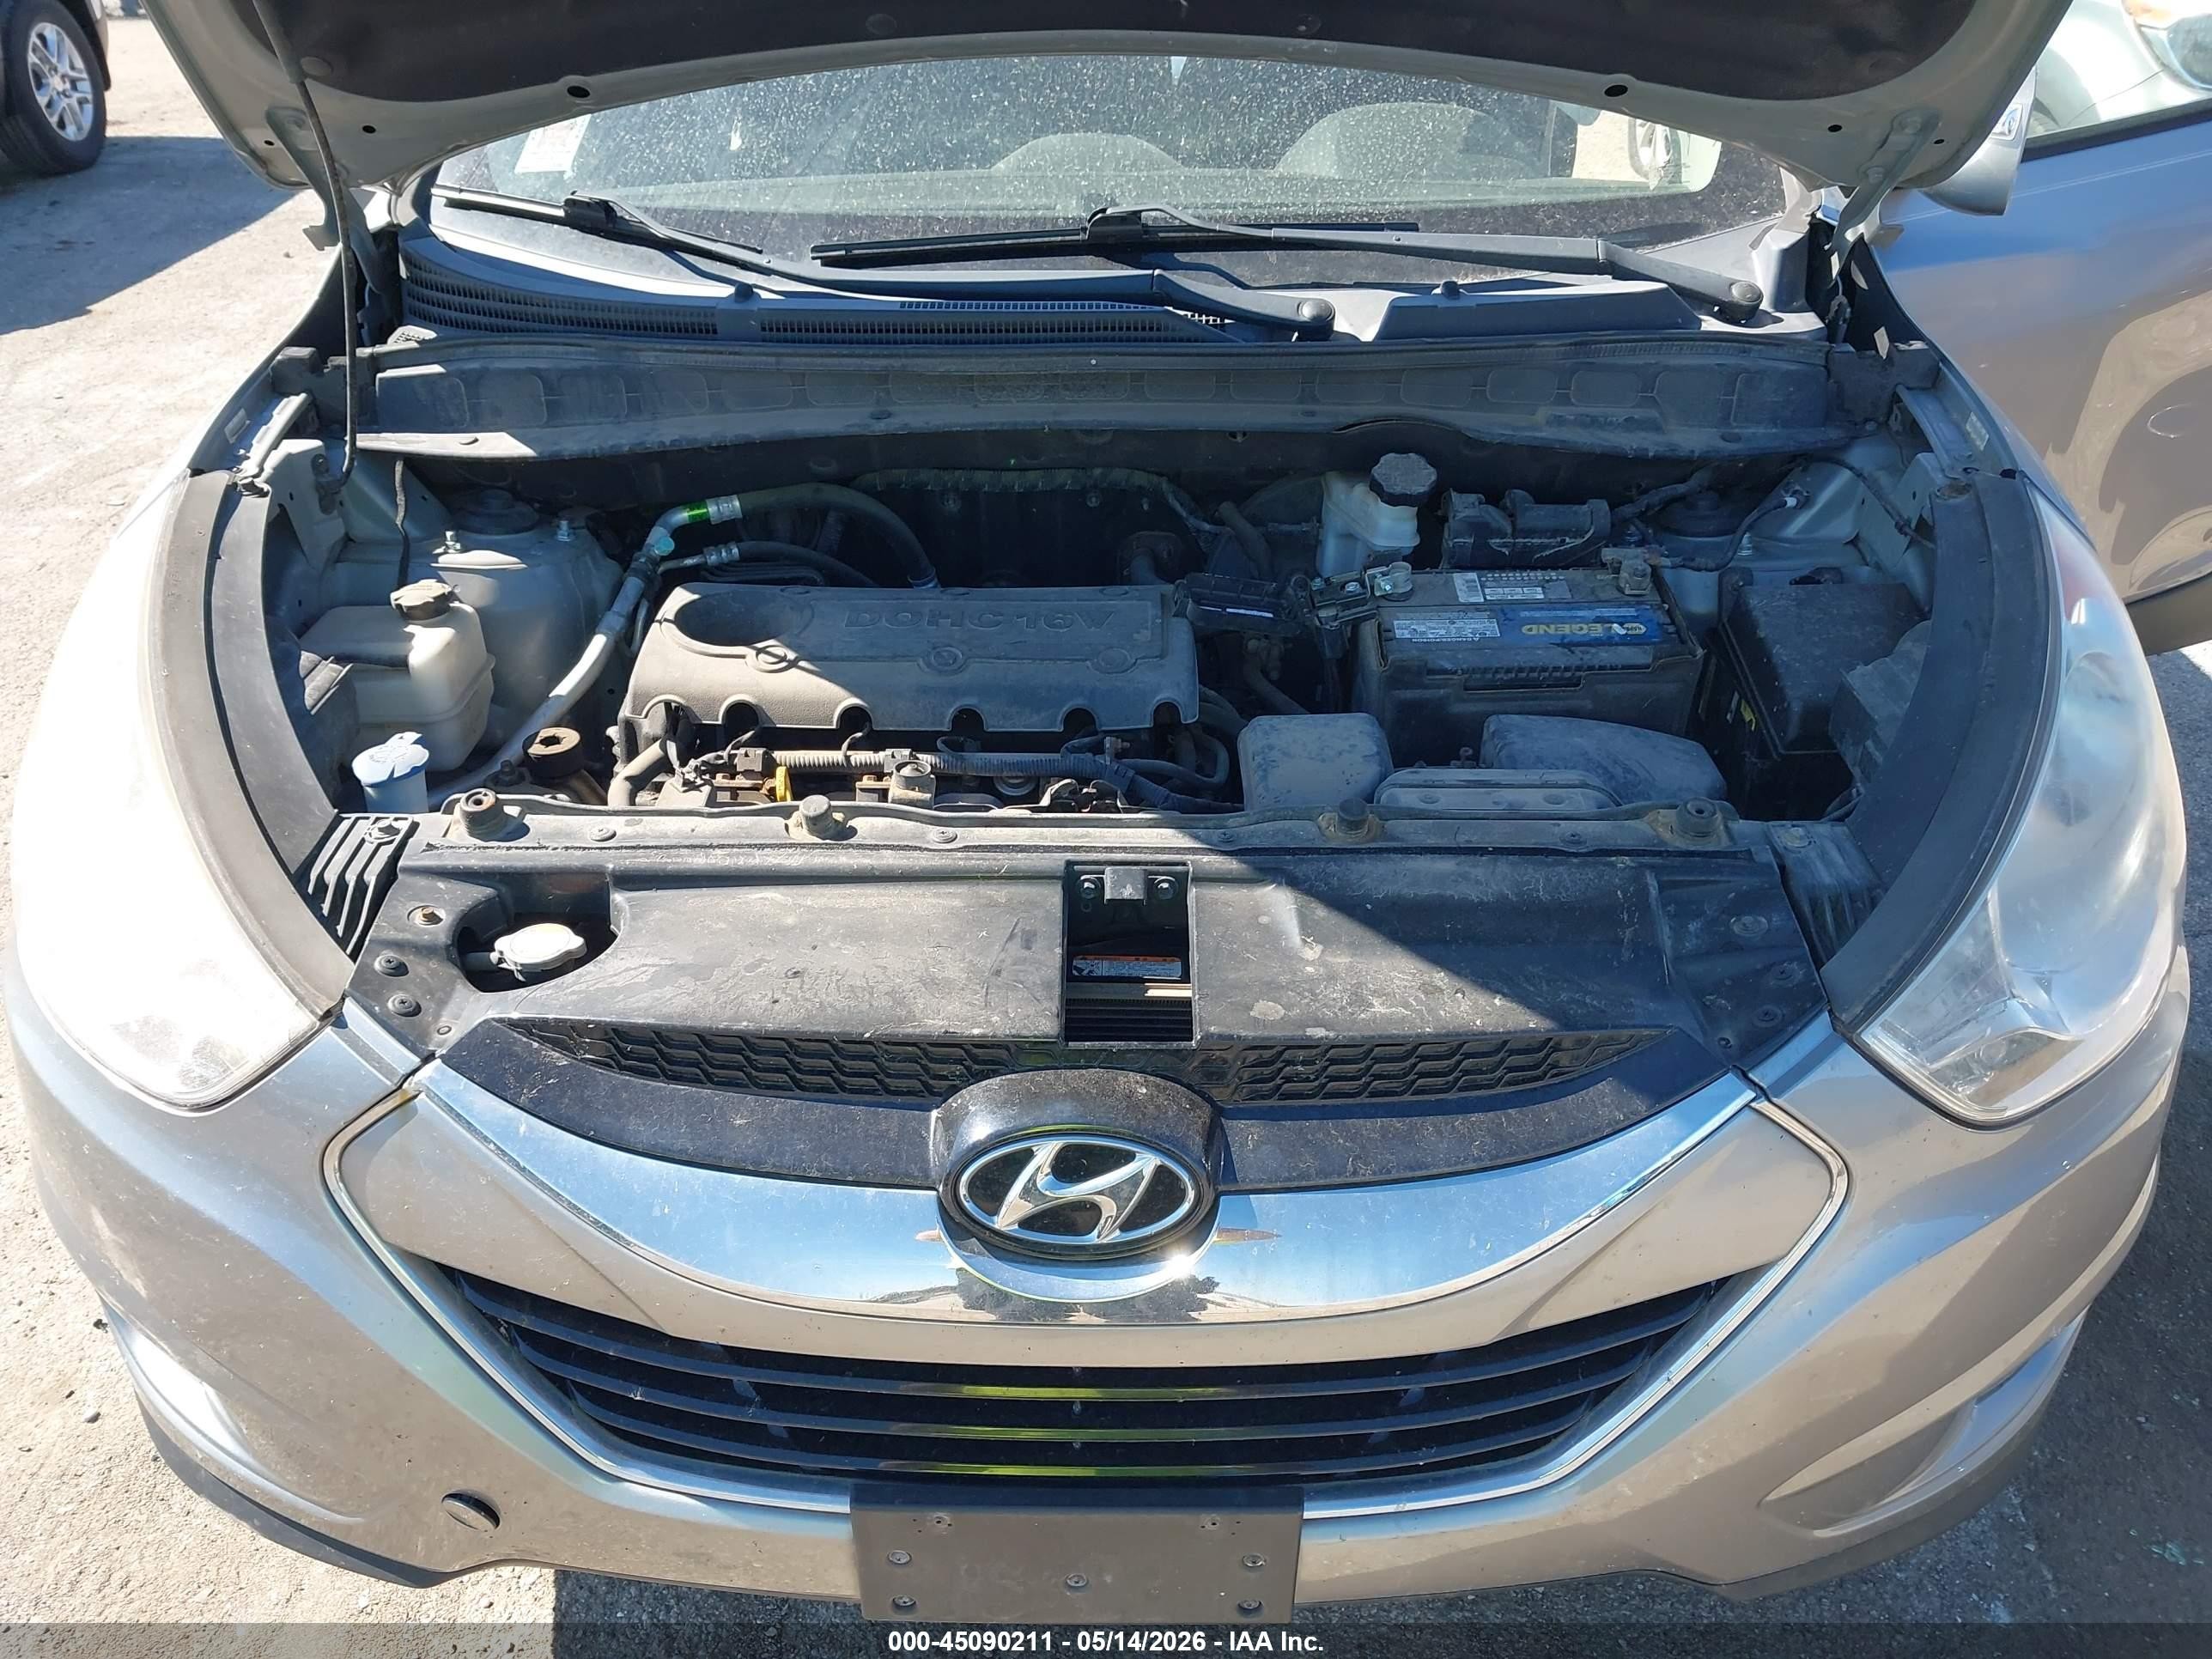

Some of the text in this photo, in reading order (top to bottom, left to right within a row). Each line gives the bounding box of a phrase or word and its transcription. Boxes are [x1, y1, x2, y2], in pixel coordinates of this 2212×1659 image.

[844, 610, 1115, 632] DOHC 16V
[1521, 623, 1614, 635] LEGEND
